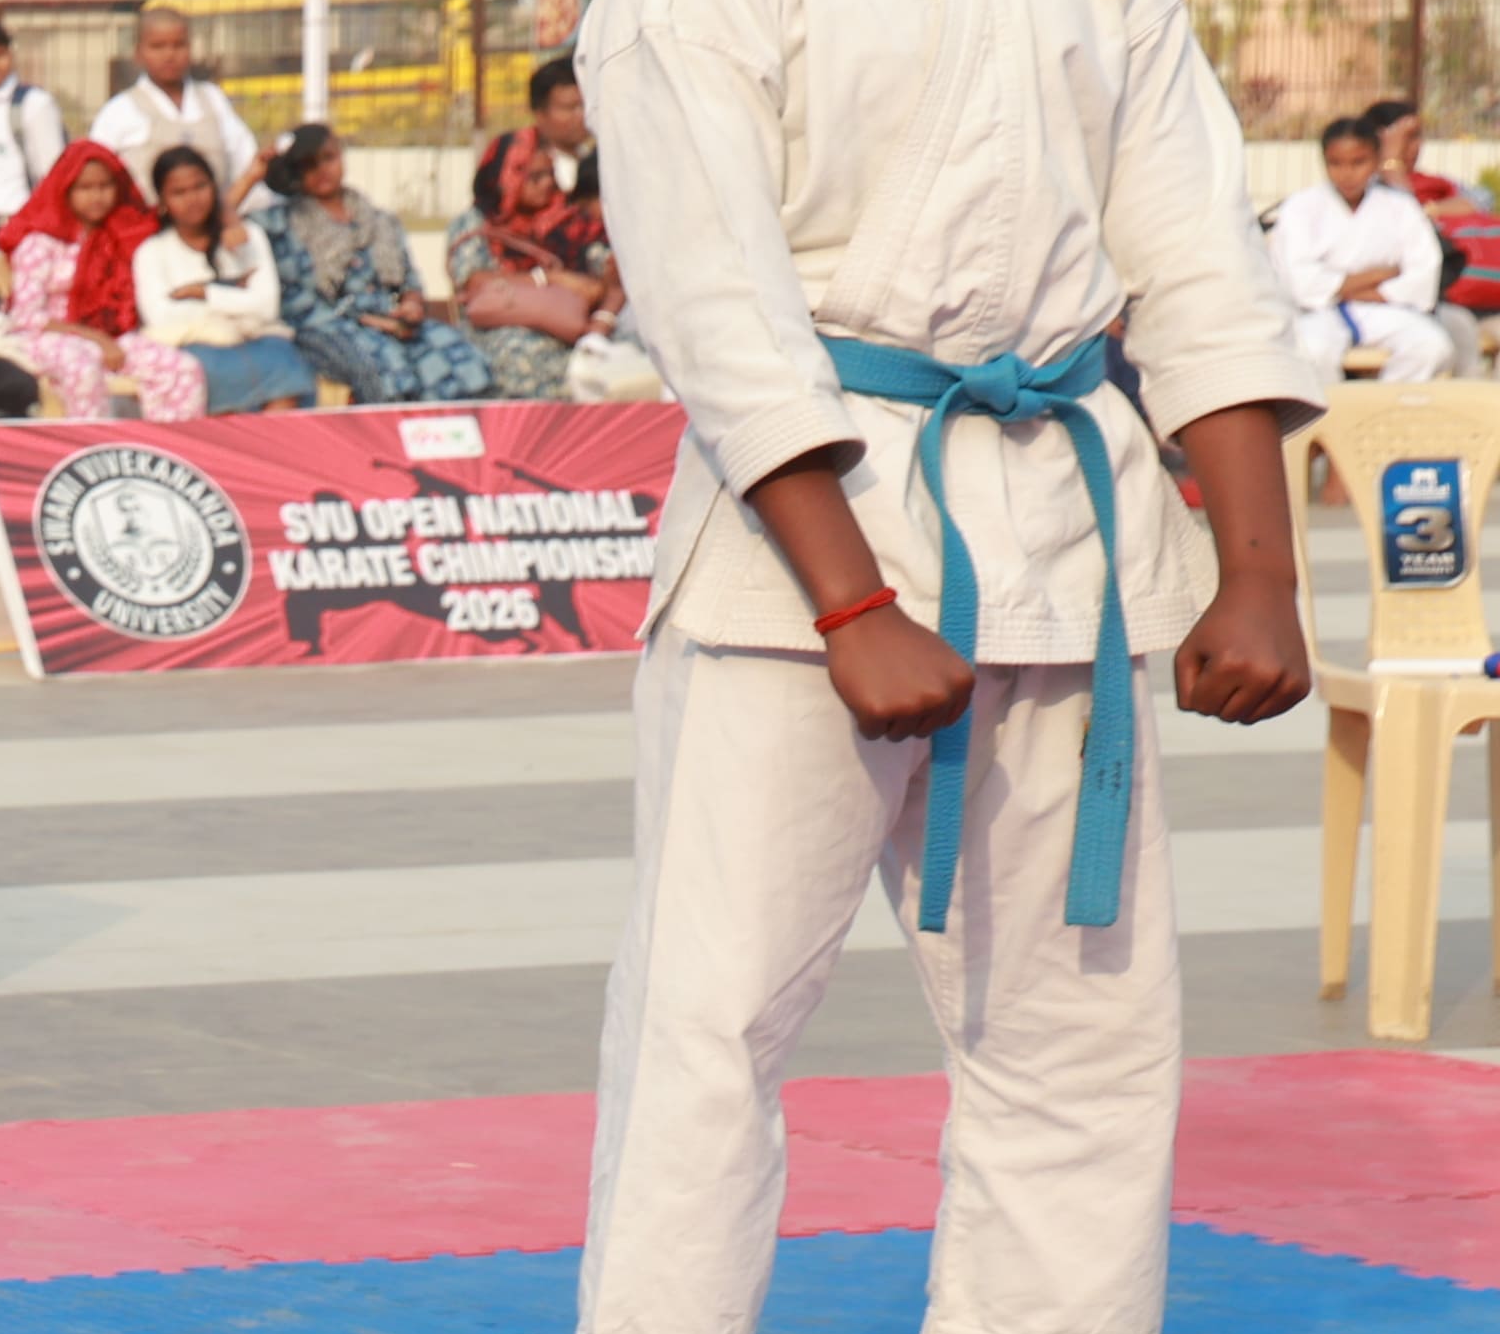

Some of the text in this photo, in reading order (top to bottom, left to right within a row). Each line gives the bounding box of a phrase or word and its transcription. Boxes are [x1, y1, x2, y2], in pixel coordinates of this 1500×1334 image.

[279, 489, 647, 543] SVU OPEN NATIONAL
[1394, 506, 1456, 553] 3
[269, 533, 655, 590] KARATE CHIMPIONSHI
[440, 588, 539, 631] 2026
